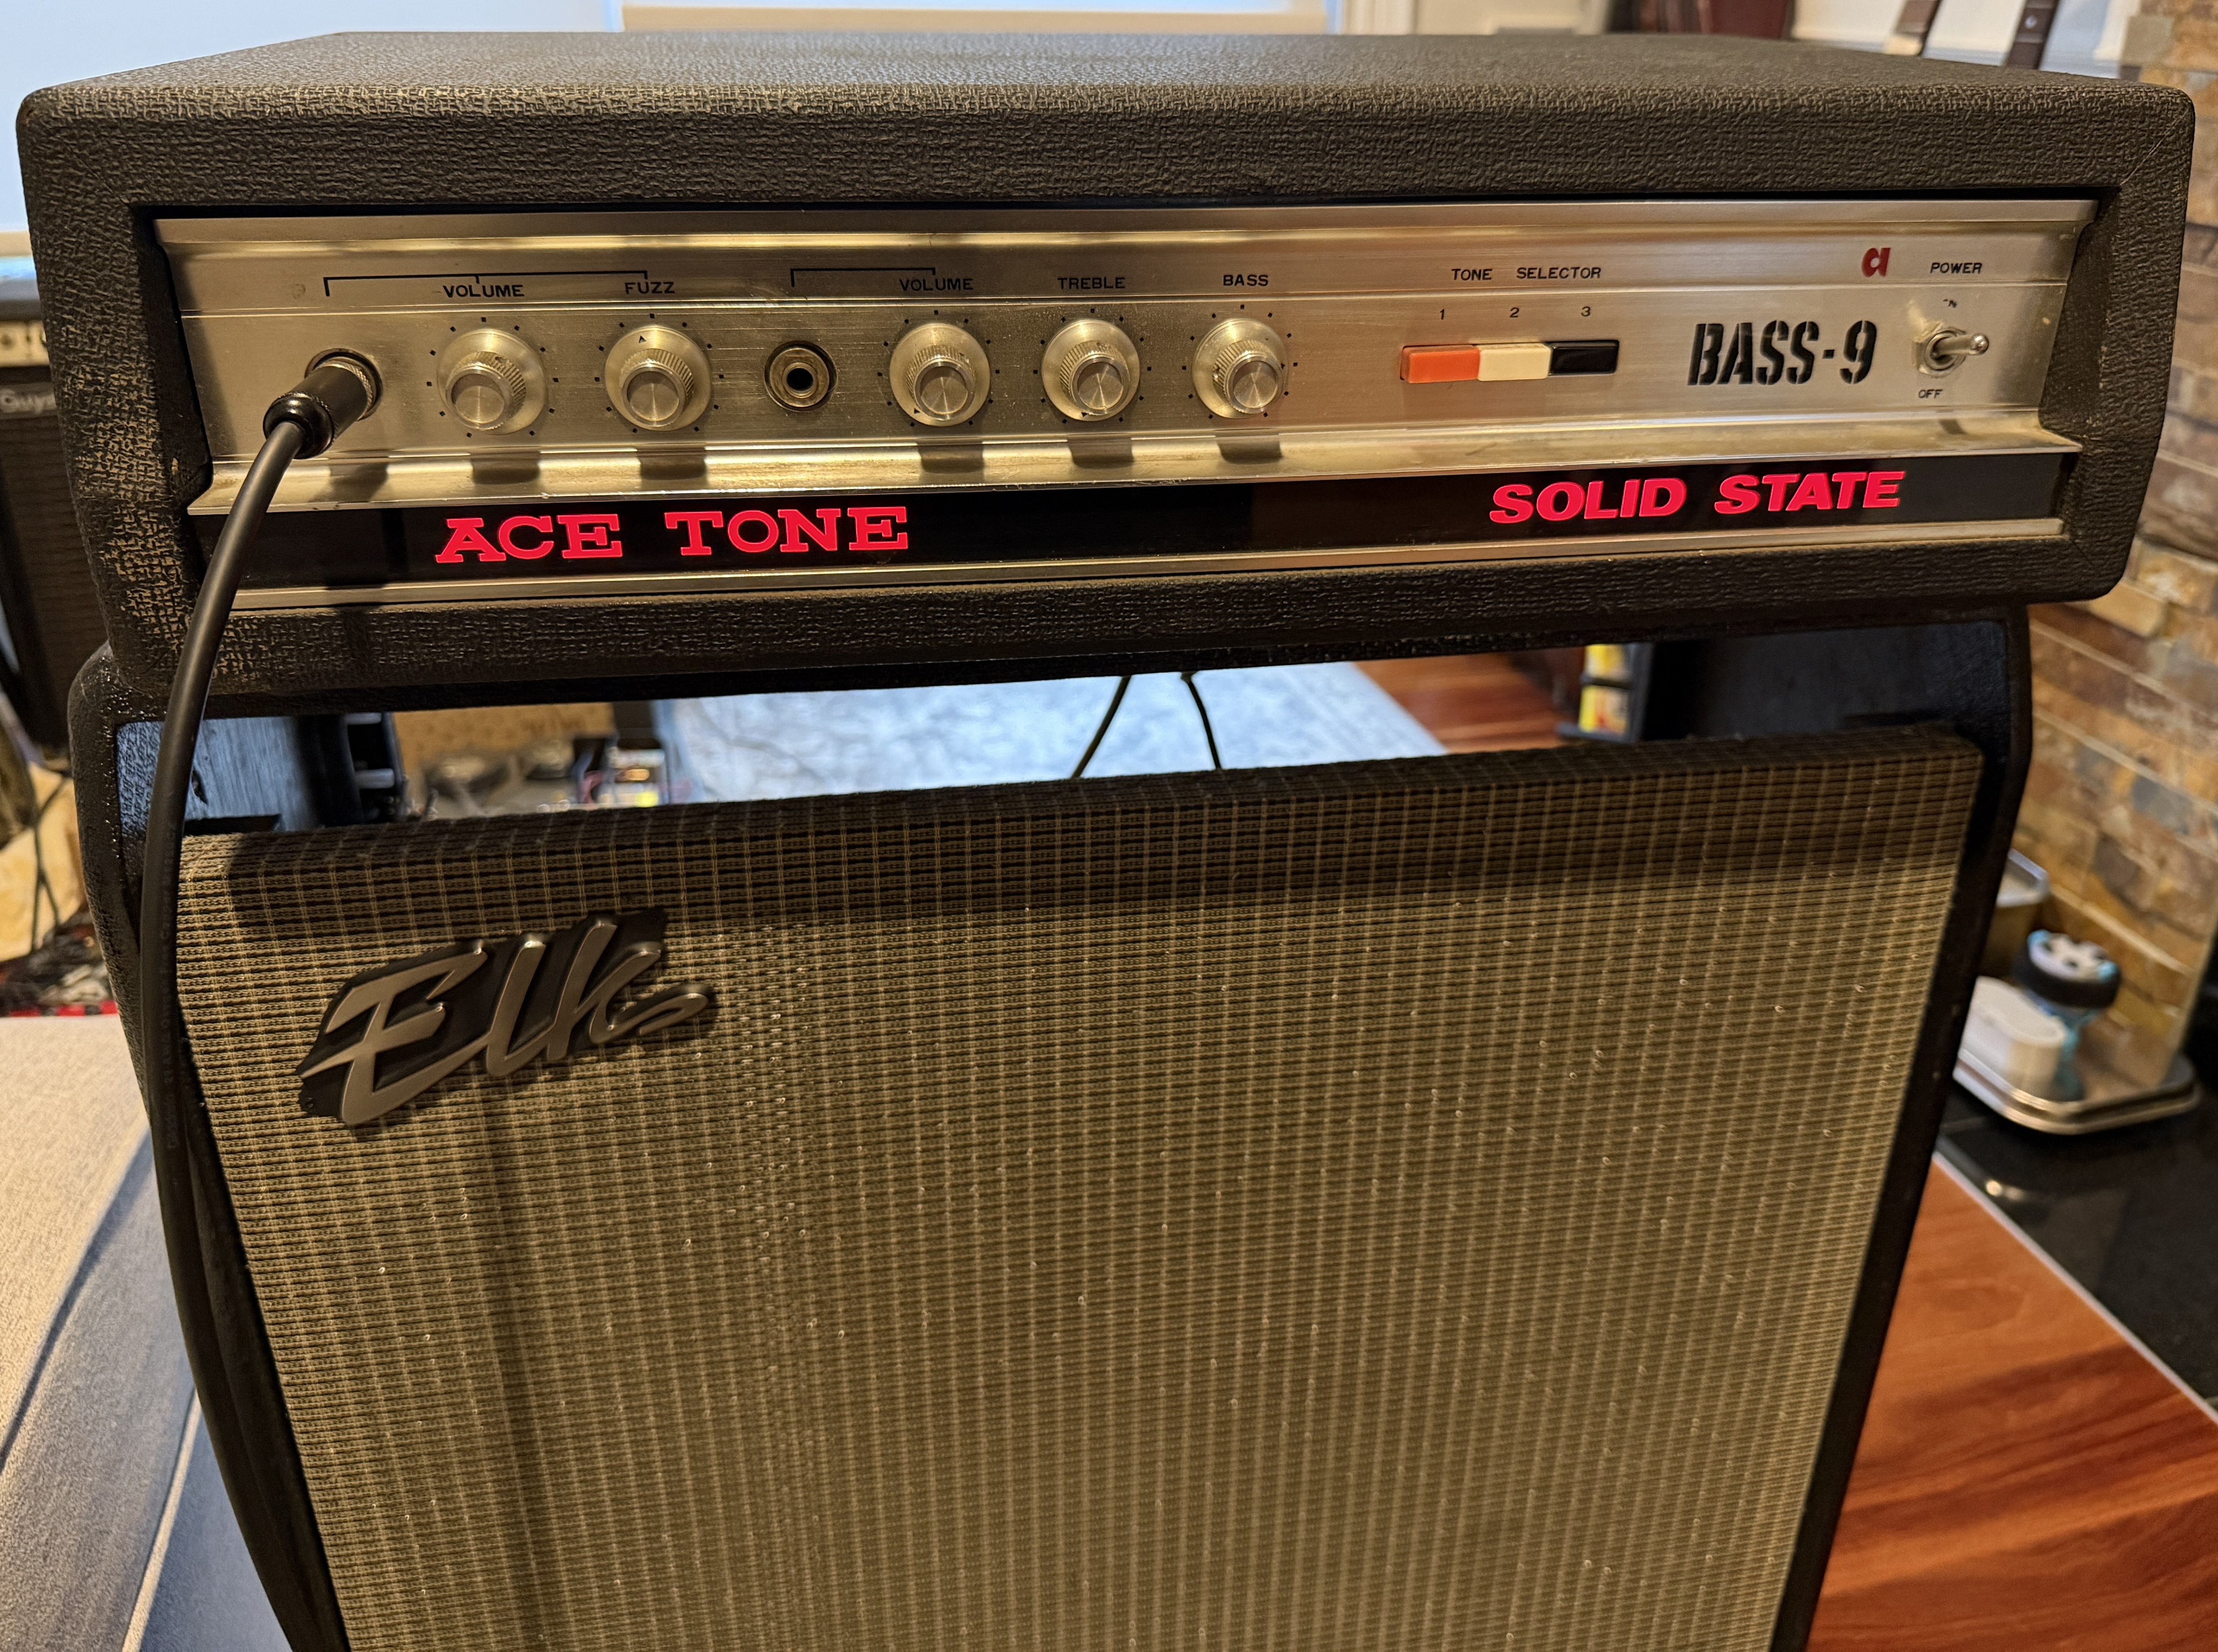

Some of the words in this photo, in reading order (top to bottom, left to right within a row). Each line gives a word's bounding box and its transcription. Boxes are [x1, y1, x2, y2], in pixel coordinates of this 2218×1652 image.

[1451, 268, 1493, 281] TONE
[1516, 266, 1601, 279] SELECTOR
[1930, 262, 1983, 274] POWER
[898, 277, 974, 292] VOLUME
[1057, 277, 1125, 290] TREBLE
[1223, 274, 1269, 287] BASS
[442, 284, 525, 298] VOLUME
[624, 281, 676, 295] FUZZ
[1439, 309, 1445, 320] 1
[1509, 307, 1519, 318] 2
[1581, 306, 1591, 317] 3
[1687, 320, 1878, 386] BASS-9
[1918, 389, 1943, 399] OFF
[1489, 478, 1687, 524] SOLID
[1714, 471, 1906, 514] STATE
[435, 514, 623, 563] ACE
[664, 506, 908, 556] TONE
[300, 919, 709, 1126] Elk
